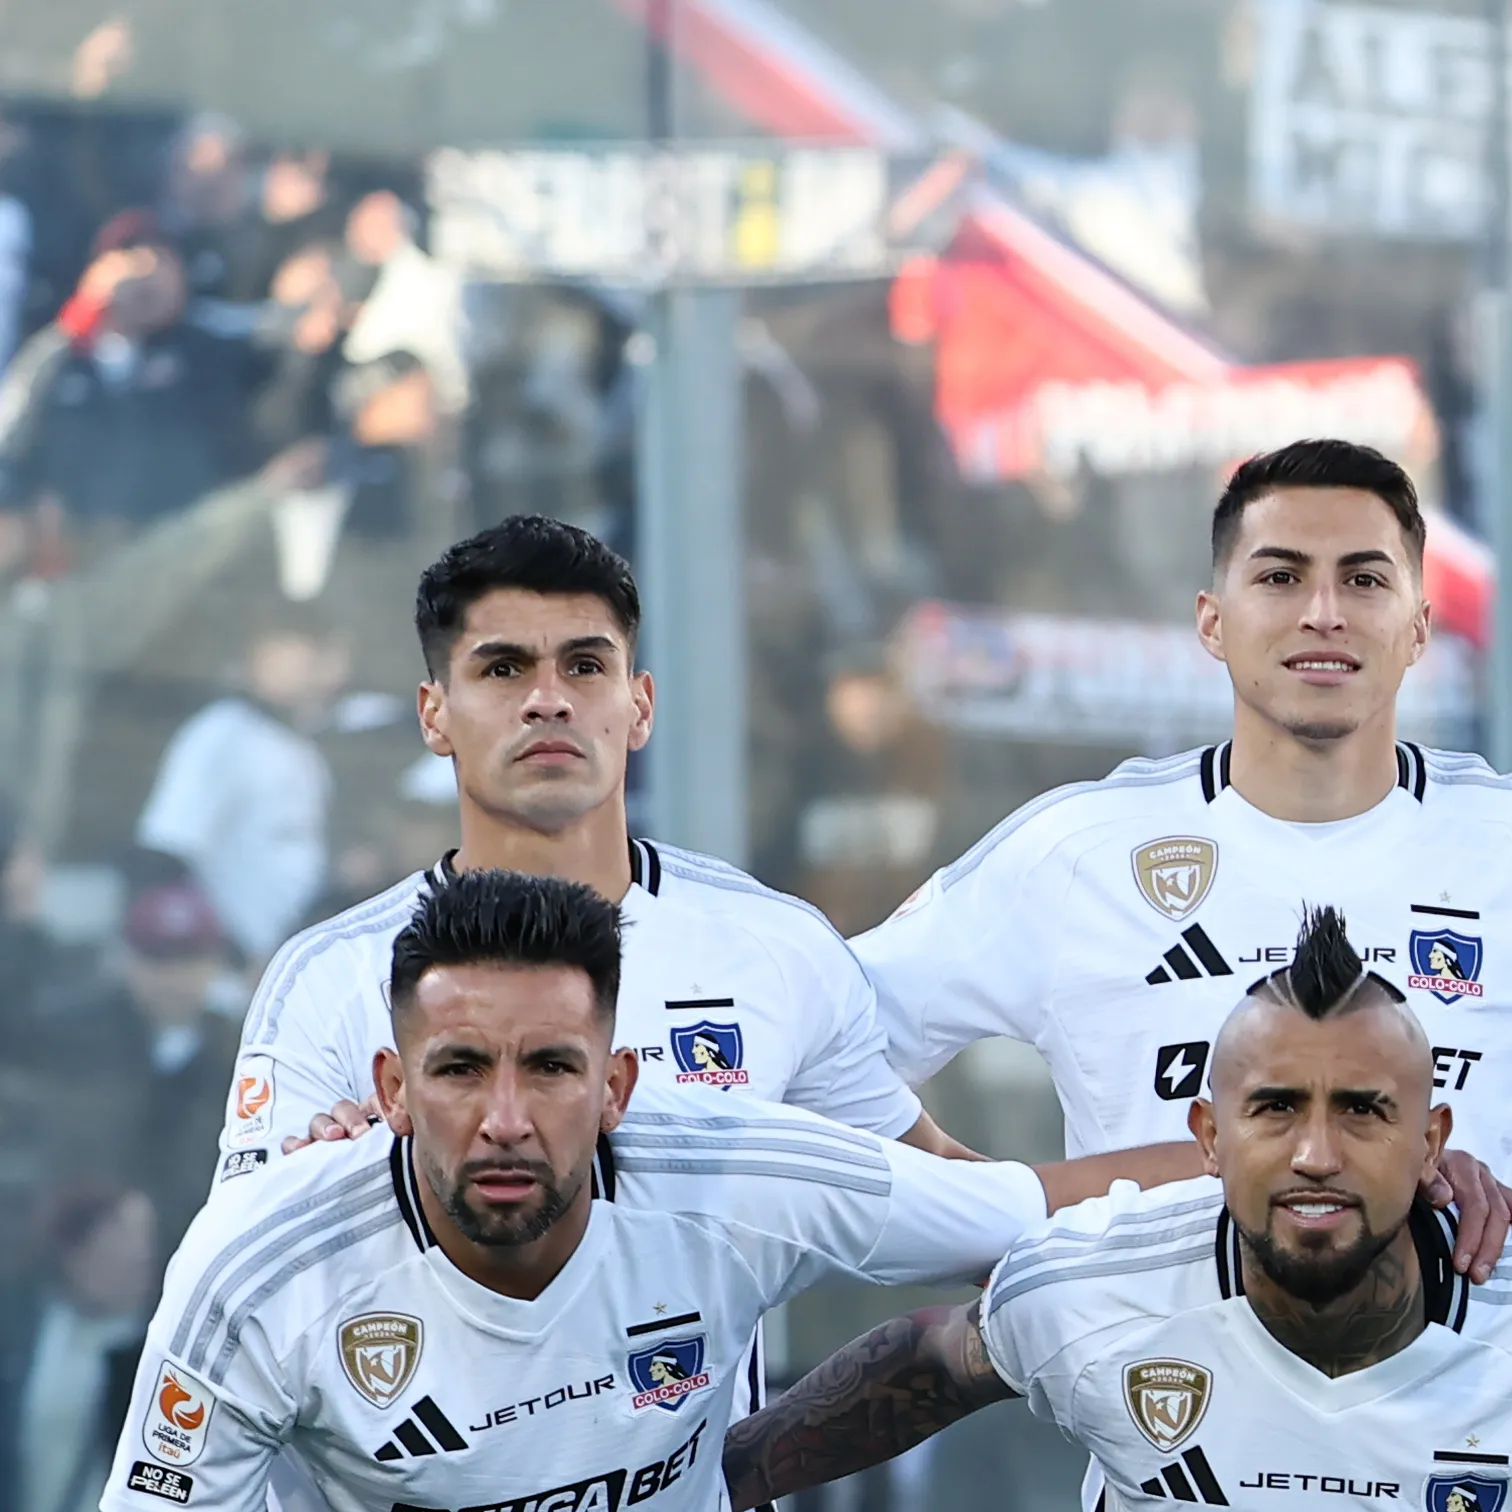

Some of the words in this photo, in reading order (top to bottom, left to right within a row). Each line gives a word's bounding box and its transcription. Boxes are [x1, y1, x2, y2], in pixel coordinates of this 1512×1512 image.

[1149, 844, 1202, 860] CAMPEÓN
[1239, 946, 1397, 964] JEUR
[1410, 975, 1482, 996] COLO-COLO
[353, 1321, 408, 1338] CAMPEÓN
[1140, 1365, 1197, 1382] CAMPEÓN
[635, 1374, 708, 1407] COLO-COLO
[469, 1373, 616, 1432] JETOUR
[151, 1429, 192, 1454] PRIMERA
[157, 1422, 178, 1438] LIGA
[179, 1431, 192, 1444] DE
[157, 1443, 182, 1460] itaú
[141, 1465, 163, 1481] NO
[165, 1472, 182, 1487] SE
[1240, 1472, 1400, 1499] JETOUR
[130, 1474, 188, 1501] PELEEN
